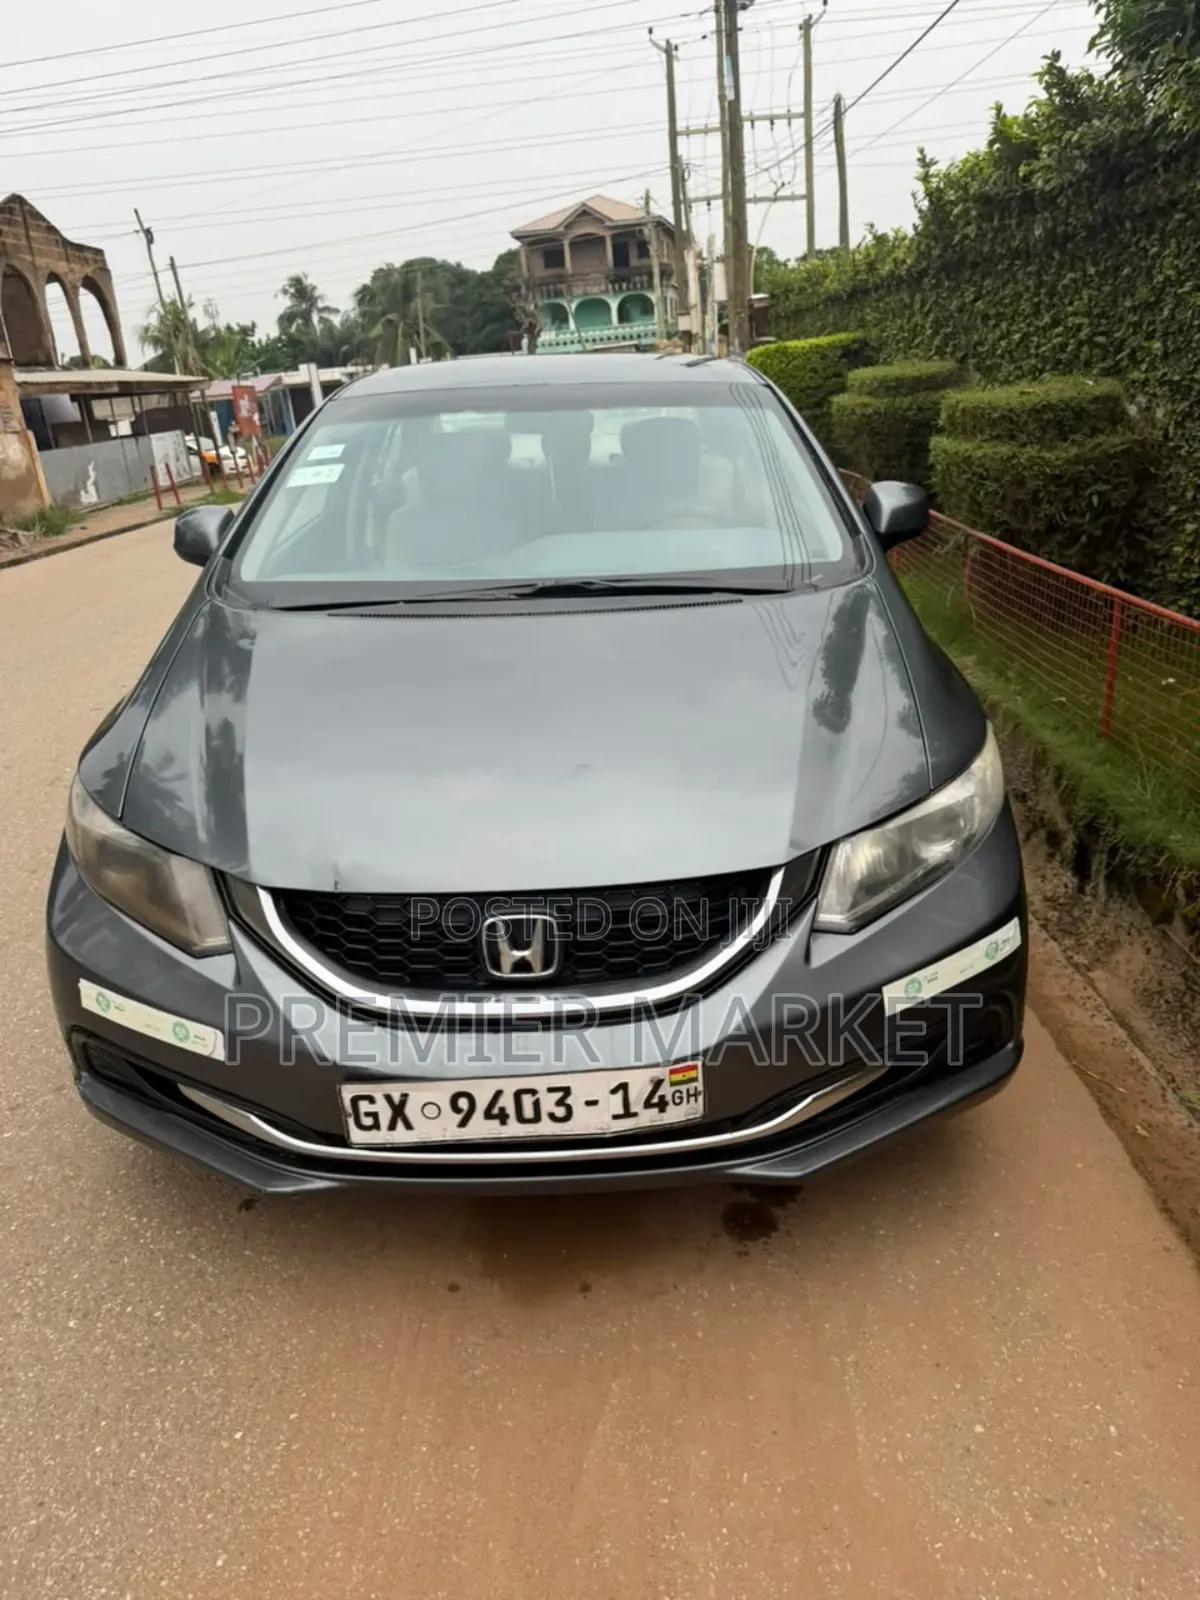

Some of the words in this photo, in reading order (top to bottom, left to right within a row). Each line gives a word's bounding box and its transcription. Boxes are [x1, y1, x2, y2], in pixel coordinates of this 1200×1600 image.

[349, 1092, 415, 1132] GX
[449, 1077, 669, 1129] 9403-14
[671, 1086, 699, 1107] GH
